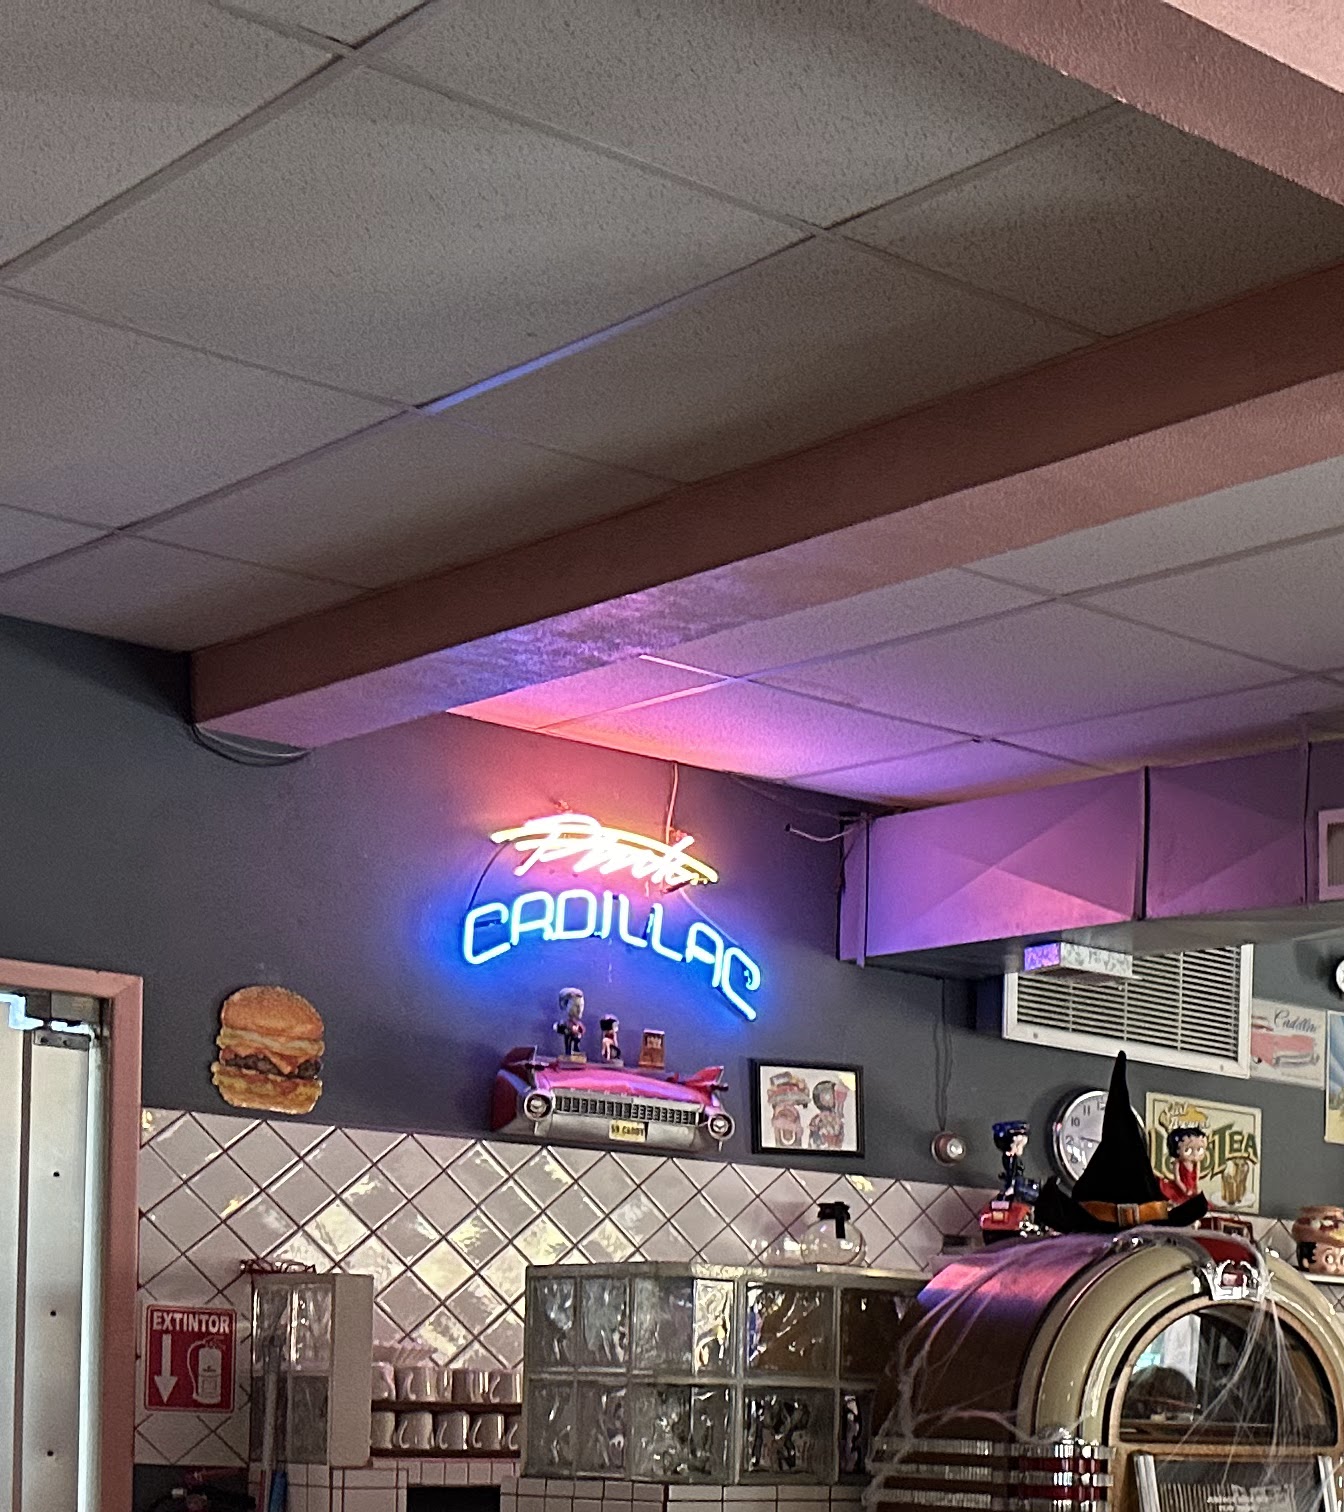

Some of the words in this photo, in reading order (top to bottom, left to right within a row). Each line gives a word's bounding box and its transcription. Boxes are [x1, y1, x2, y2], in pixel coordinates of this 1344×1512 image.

[463, 888, 762, 1022] CADILLAC
[1083, 1105, 1091, 1116] 11
[1071, 1117, 1080, 1127] 10
[152, 1311, 230, 1334] EXTINTOR
